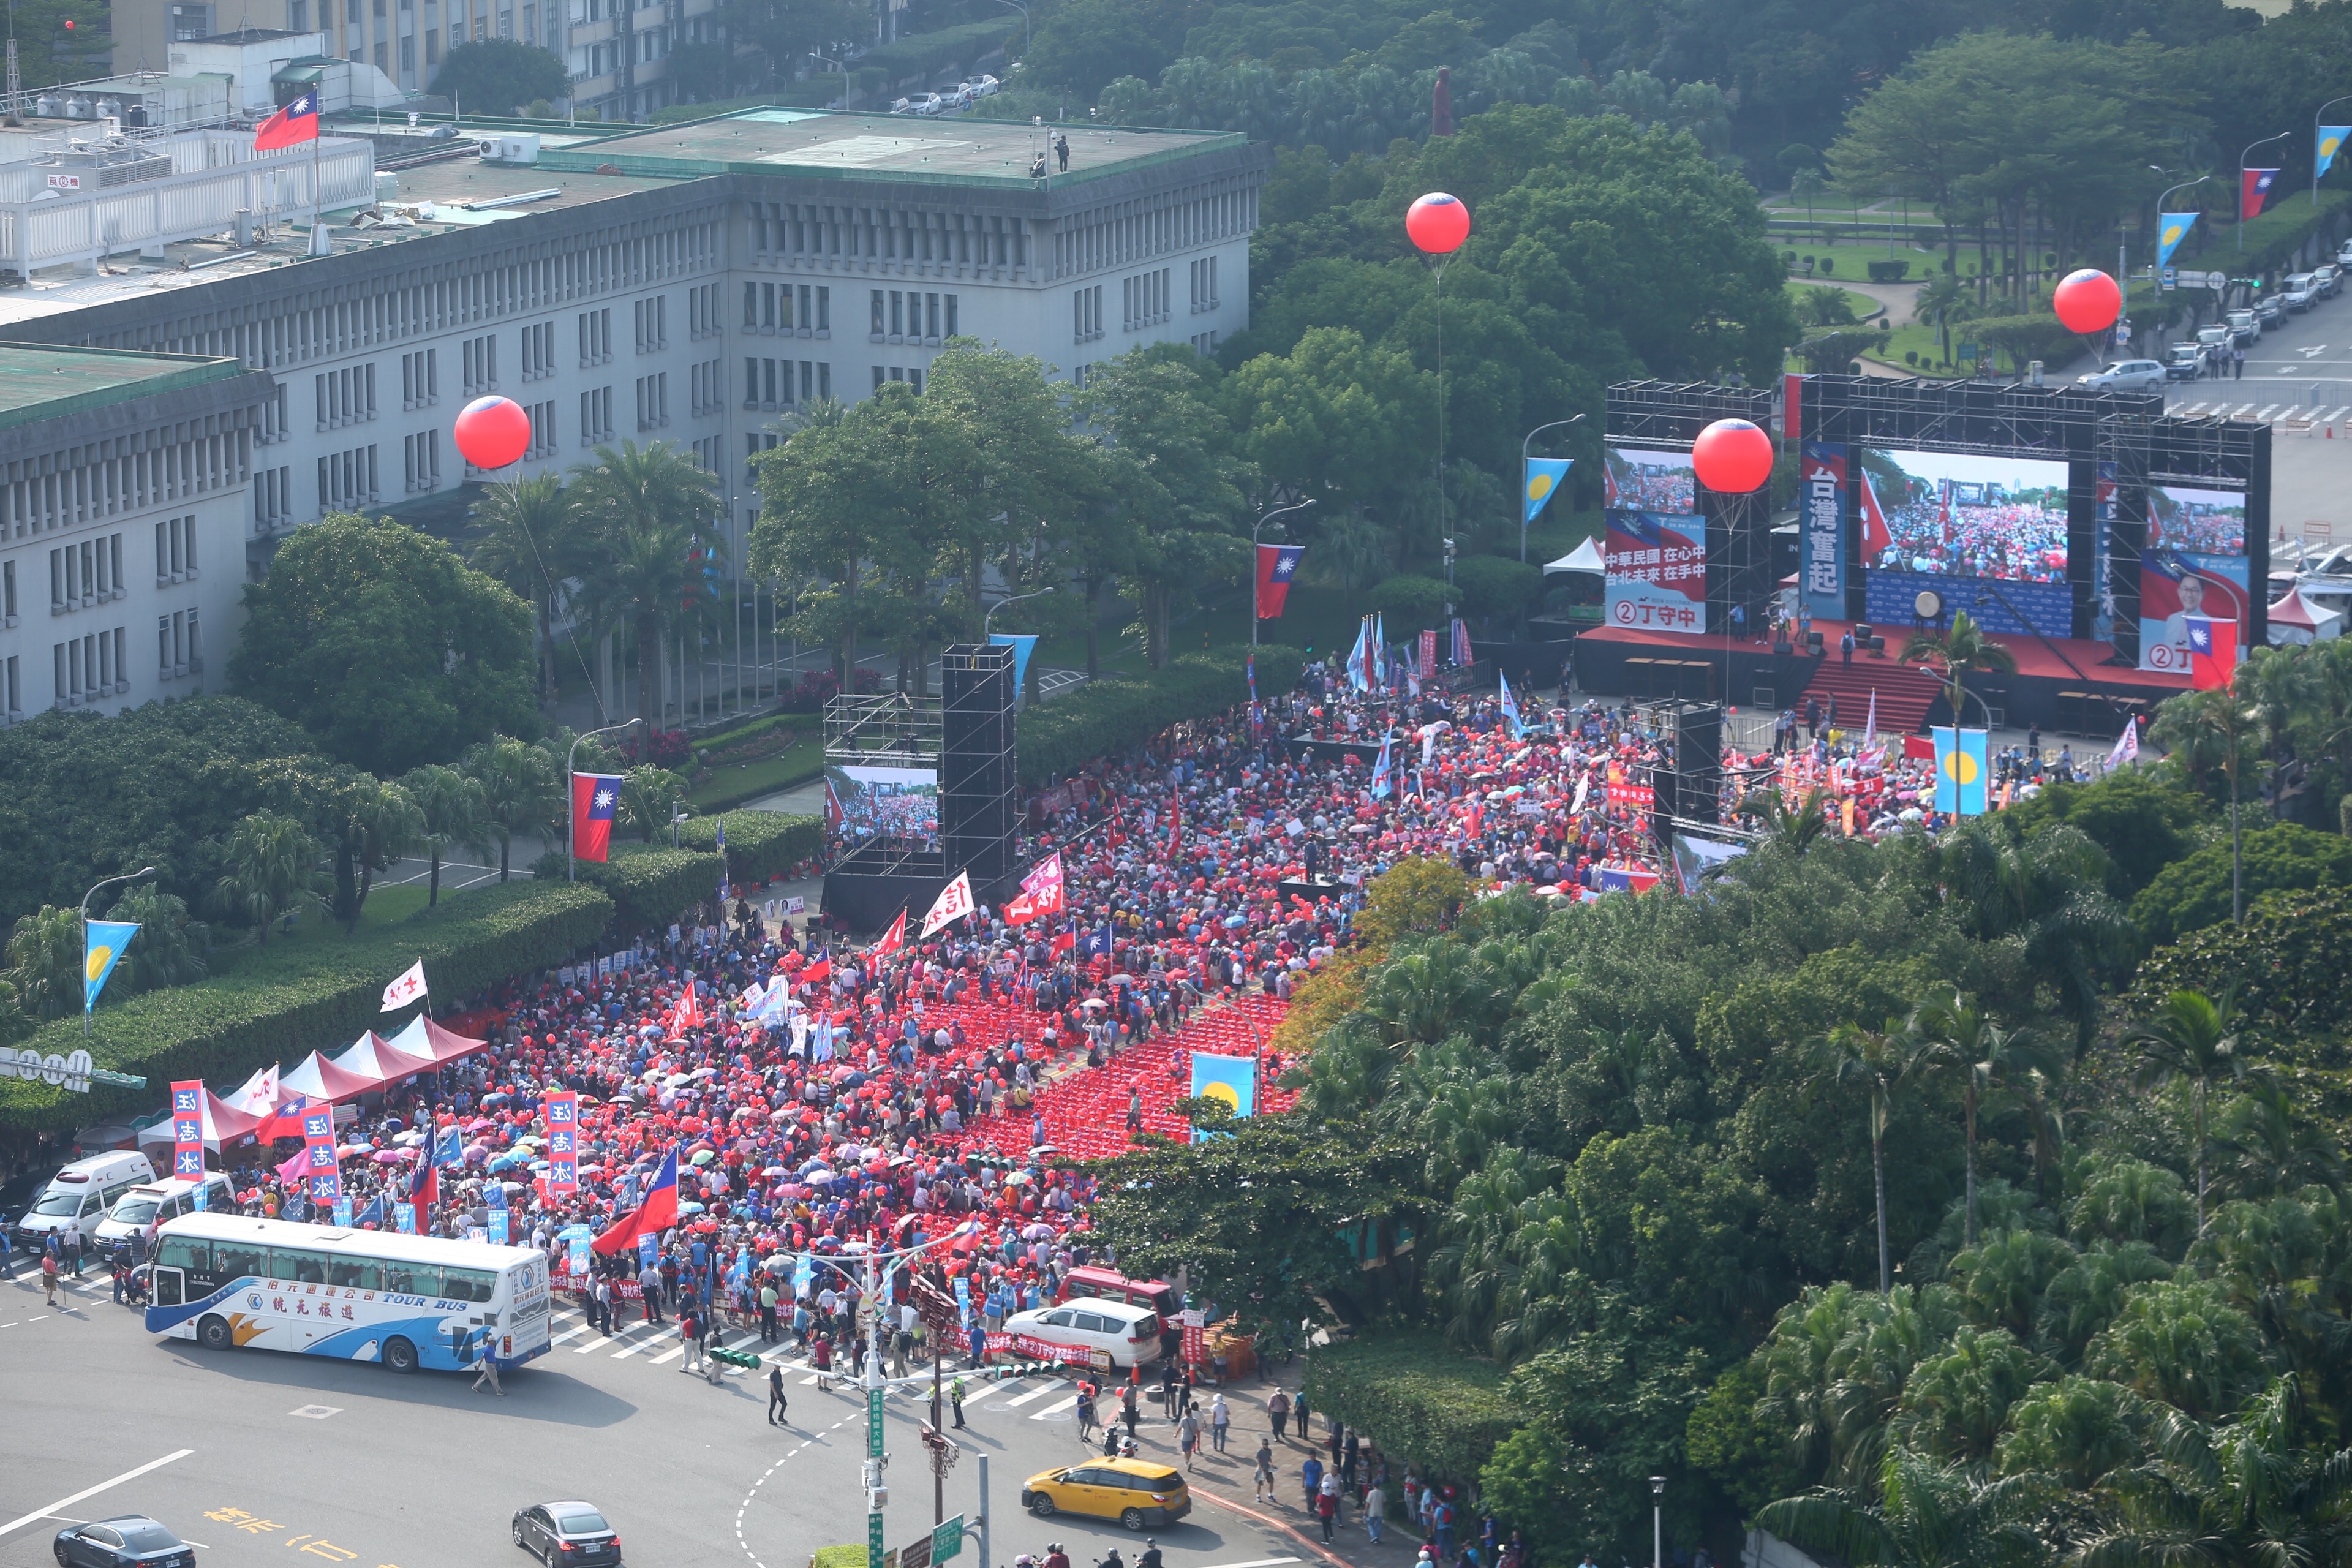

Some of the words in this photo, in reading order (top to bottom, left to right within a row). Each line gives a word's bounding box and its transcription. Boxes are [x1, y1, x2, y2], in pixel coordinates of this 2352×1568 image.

[1808, 466, 1838, 594] 台灣奮起
[1605, 548, 1660, 568] 中華民國
[1664, 544, 1706, 563] 在心中
[1605, 567, 1660, 587] 台北未來
[1664, 562, 1706, 581] 在手中
[383, 1294, 426, 1306] TOUR
[434, 1300, 468, 1311] BUS
